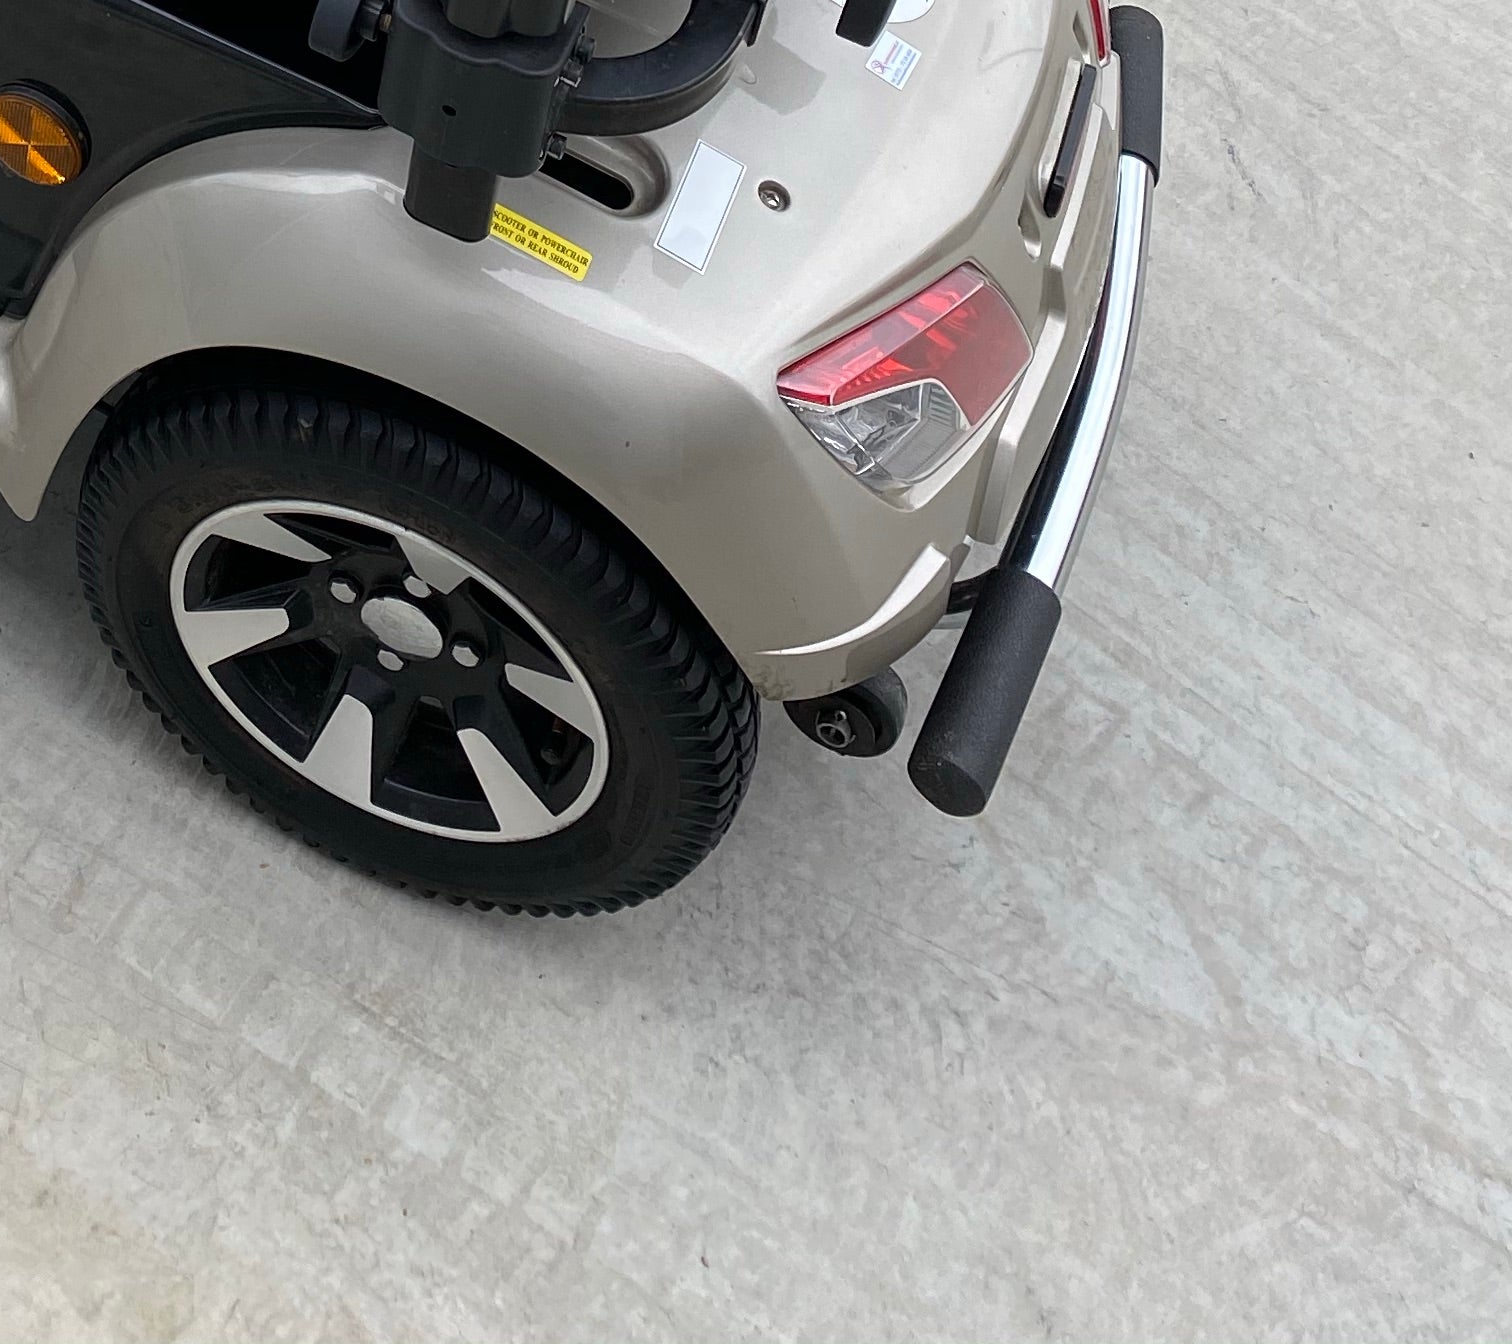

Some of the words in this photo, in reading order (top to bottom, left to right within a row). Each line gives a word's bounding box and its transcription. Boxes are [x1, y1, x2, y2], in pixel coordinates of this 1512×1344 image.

[515, 234, 526, 245] OR
[528, 242, 548, 257] REAR
[548, 252, 579, 274] SHROUD
[528, 228, 539, 239] OR
[541, 234, 589, 267] POWERCHAIR
